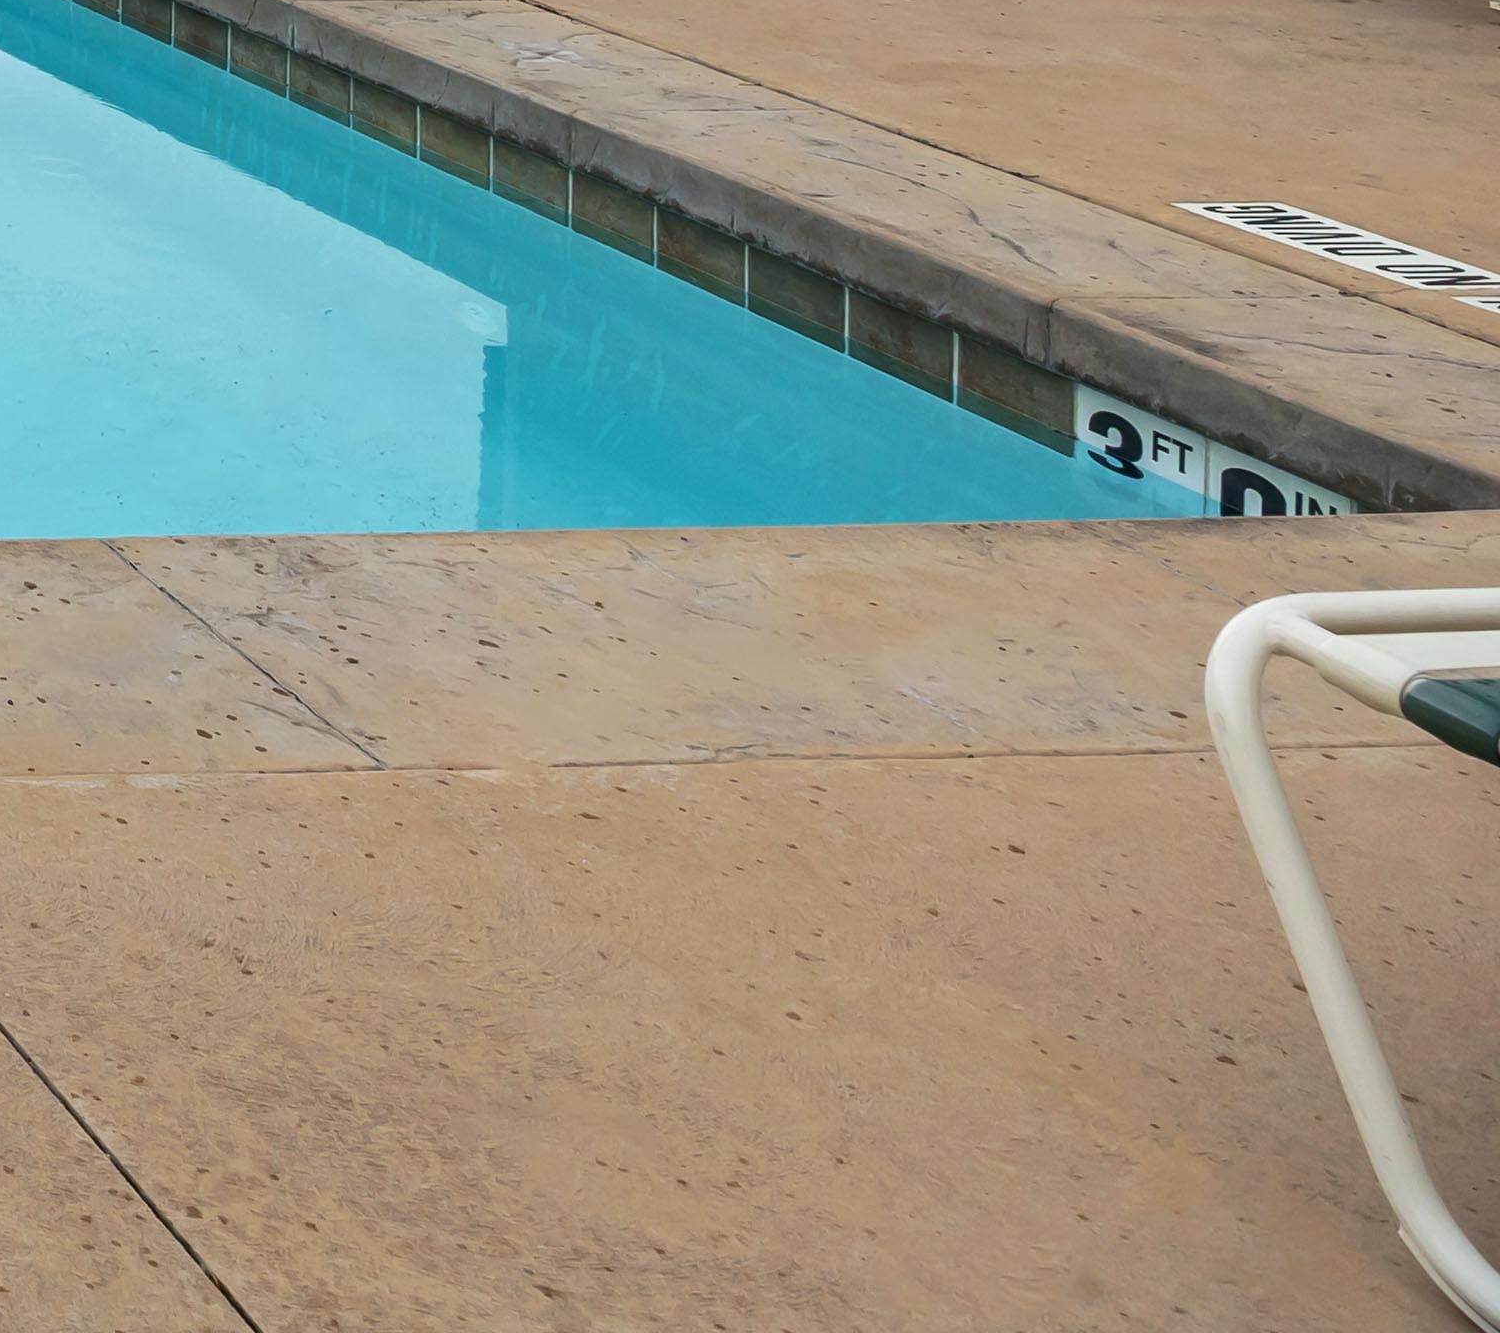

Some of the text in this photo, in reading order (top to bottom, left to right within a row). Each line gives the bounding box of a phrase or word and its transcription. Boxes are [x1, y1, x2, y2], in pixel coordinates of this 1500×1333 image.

[1202, 205, 1419, 256] DIVING
[1087, 410, 1145, 480] 3
[1151, 430, 1194, 475] FT
